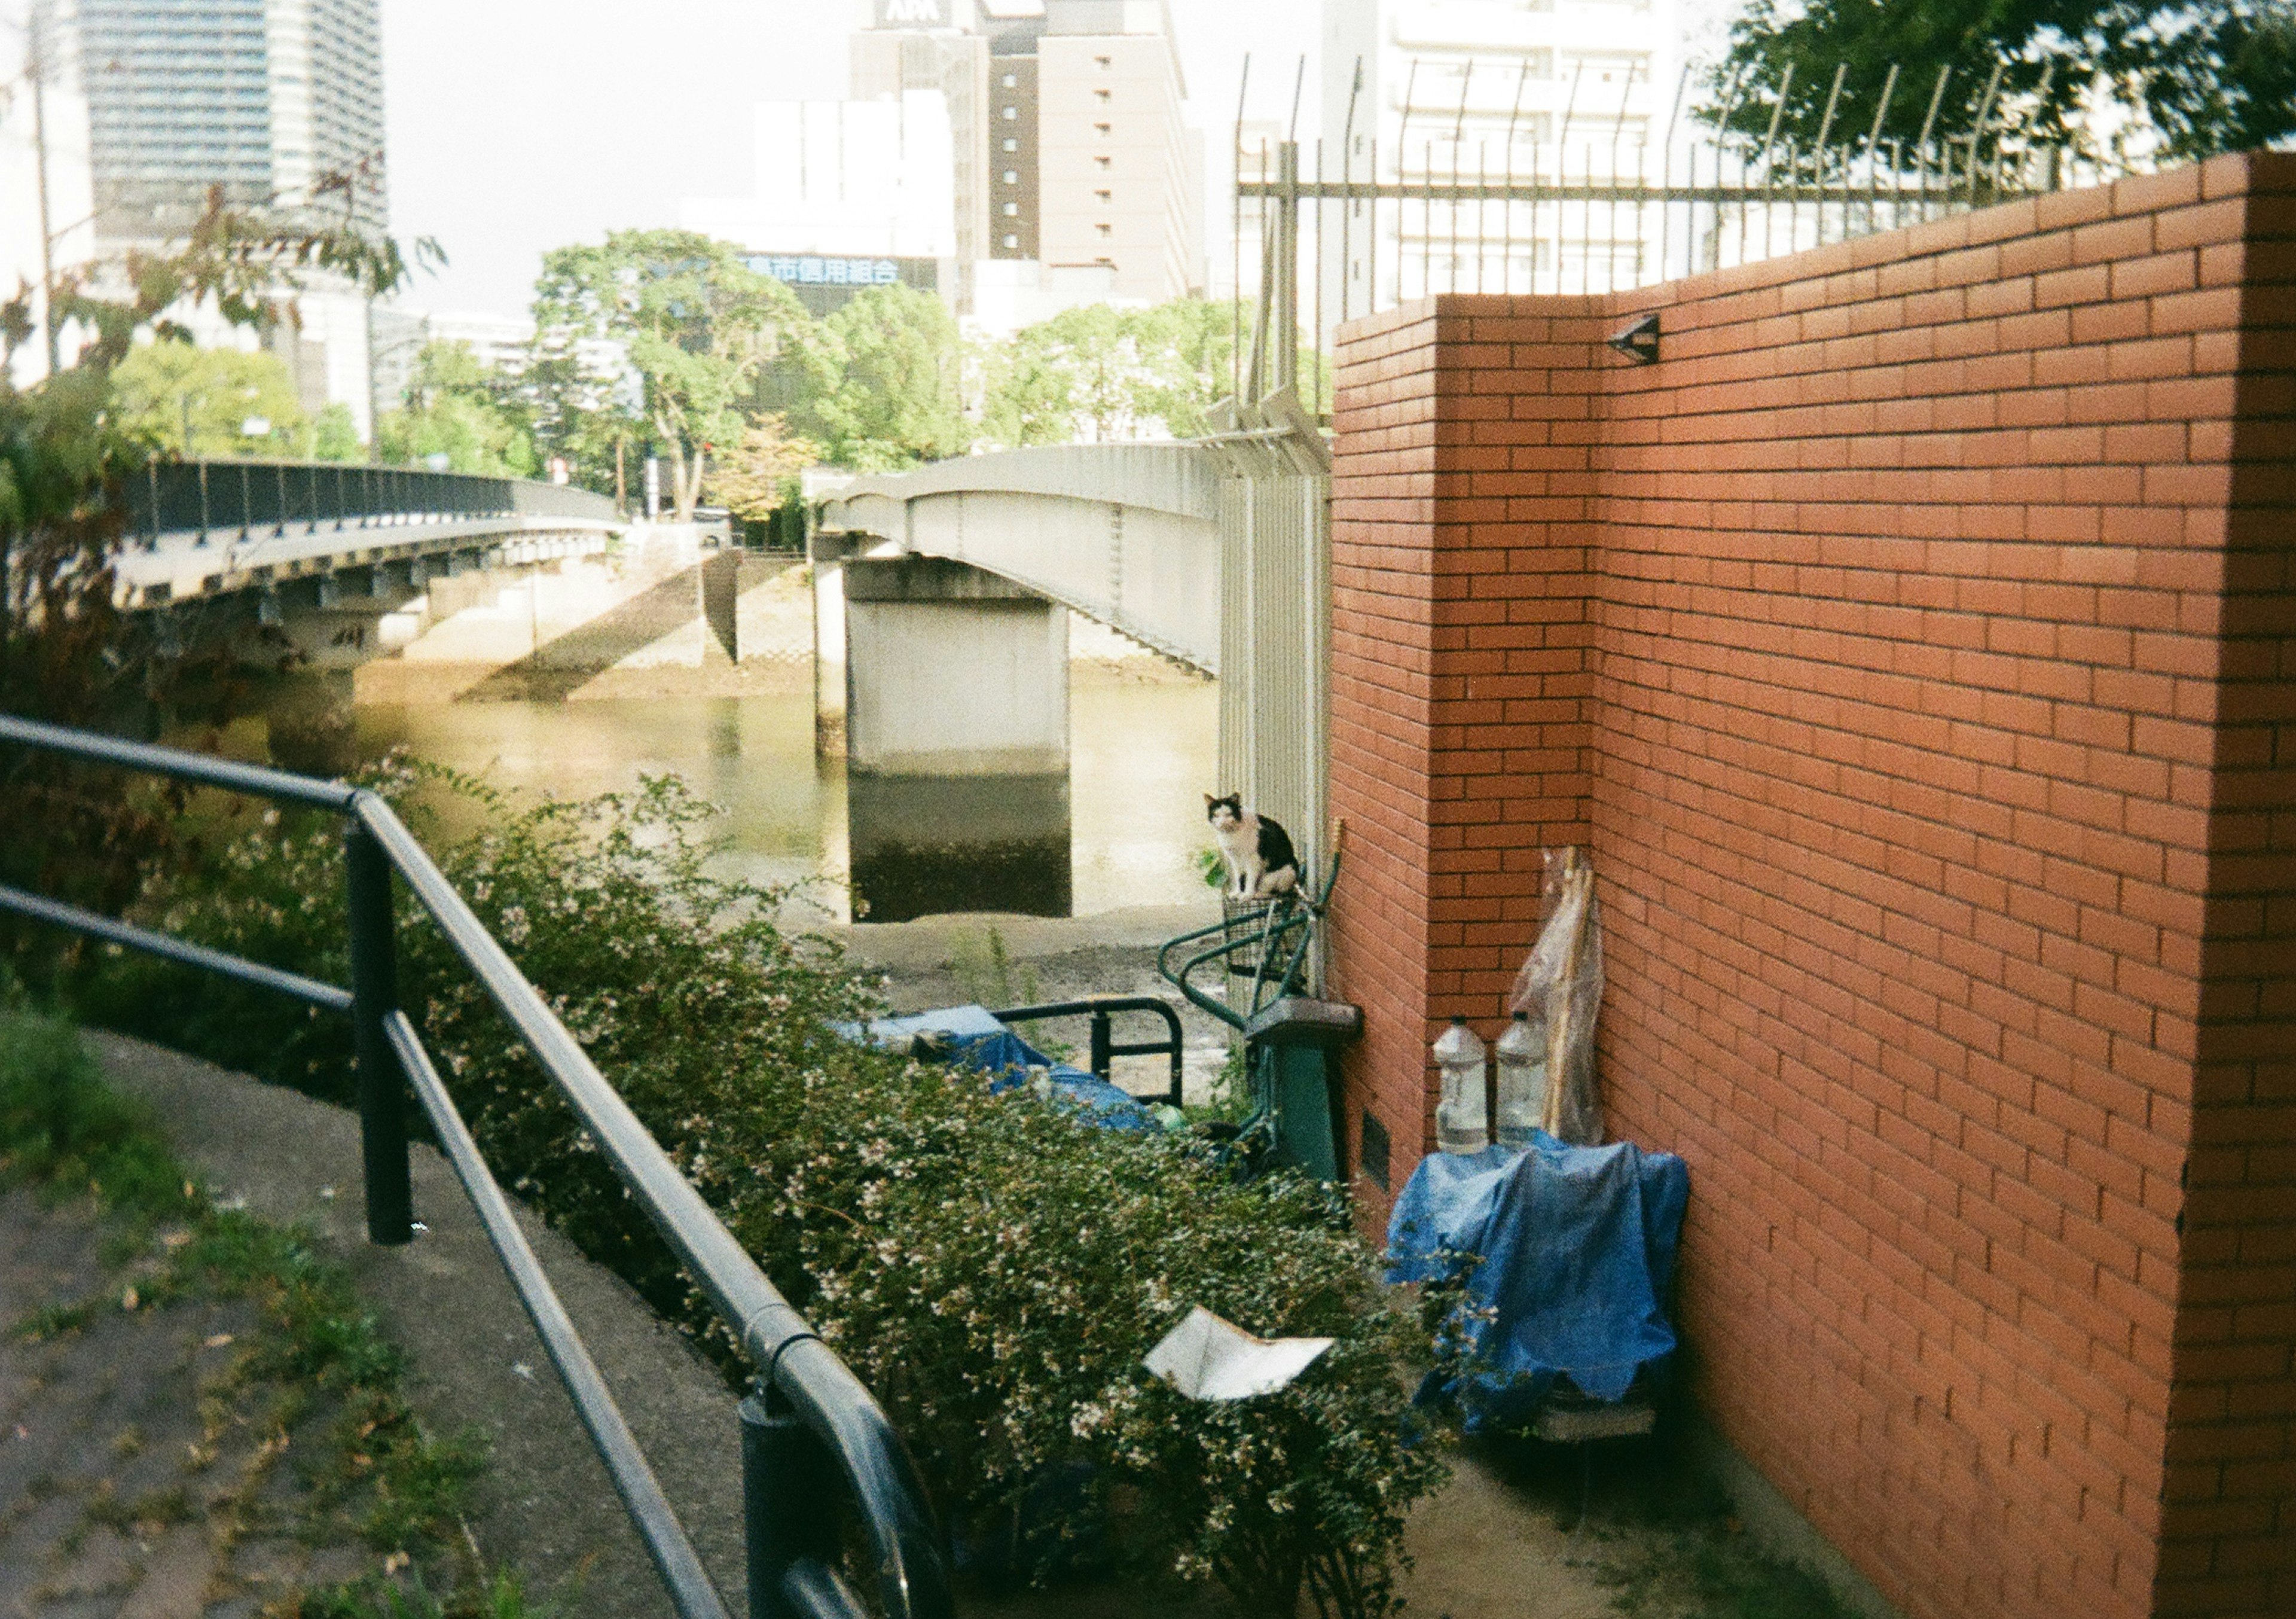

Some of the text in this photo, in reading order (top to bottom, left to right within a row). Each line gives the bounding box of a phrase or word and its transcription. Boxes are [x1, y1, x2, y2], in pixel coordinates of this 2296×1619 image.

[737, 255, 898, 283] 島市信用組合
